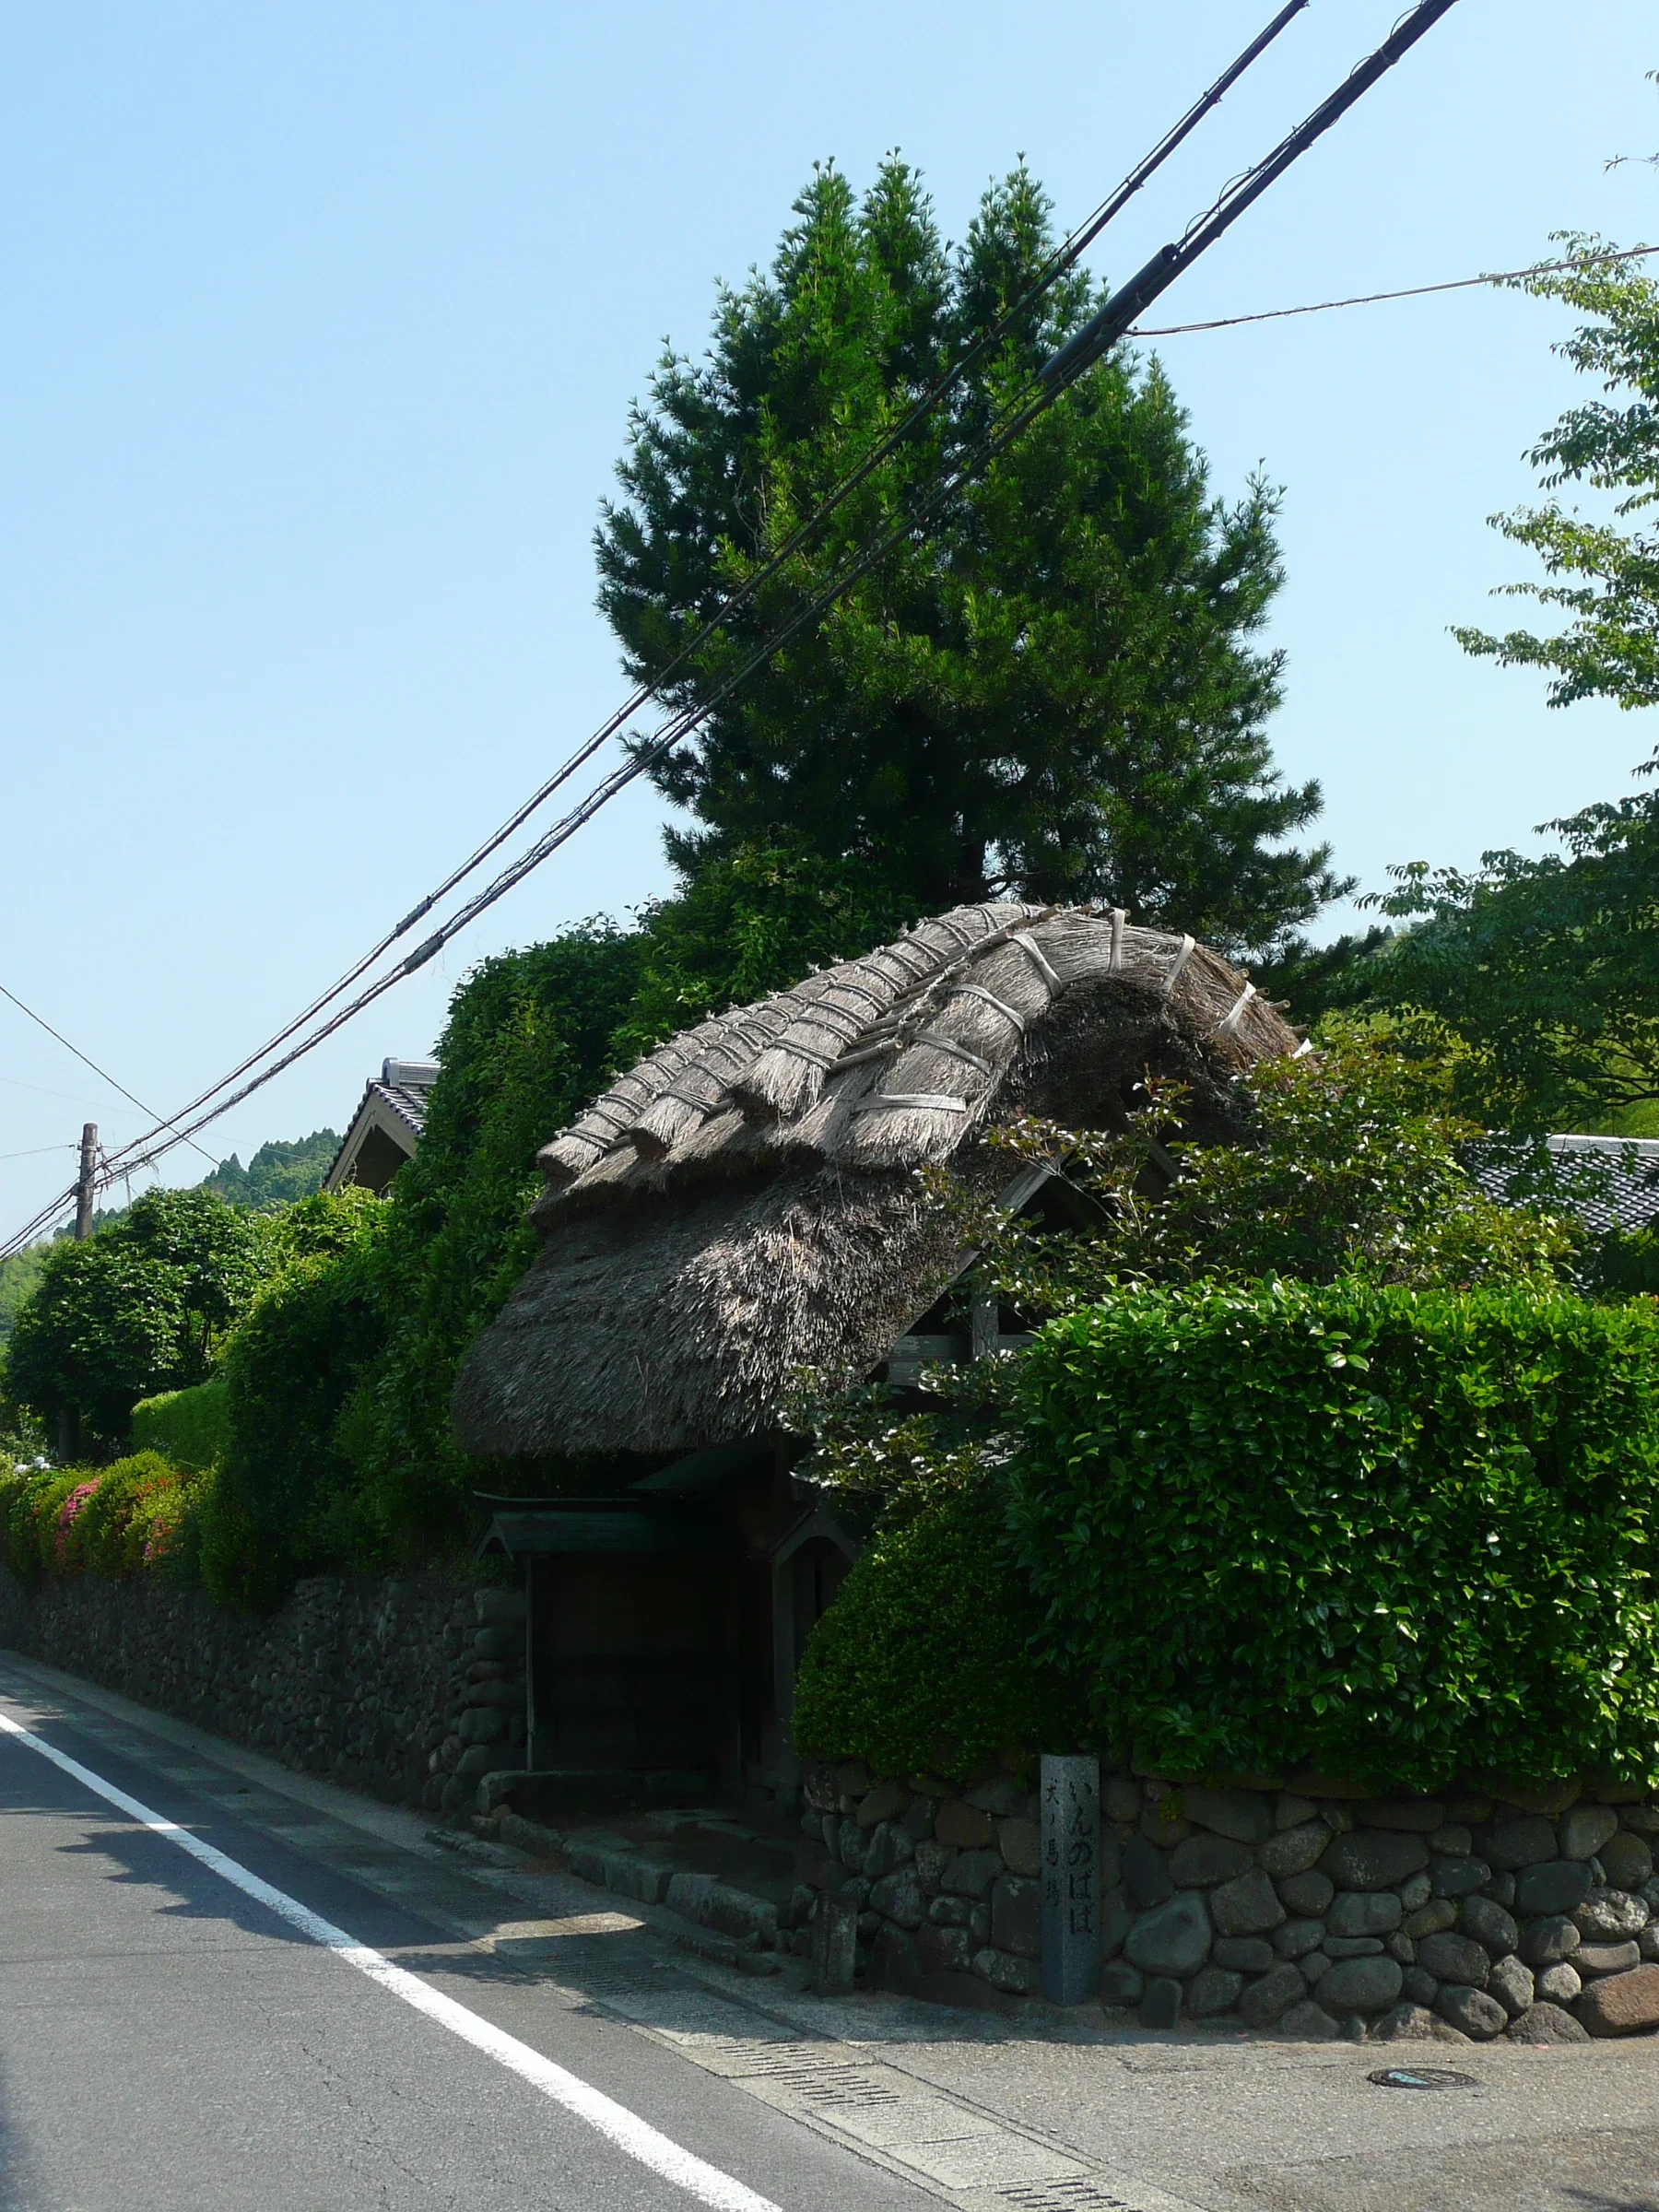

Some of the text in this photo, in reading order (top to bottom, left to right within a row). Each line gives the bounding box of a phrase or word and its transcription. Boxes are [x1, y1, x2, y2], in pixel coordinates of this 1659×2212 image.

[1067, 1780, 1096, 1936] いんのばば
